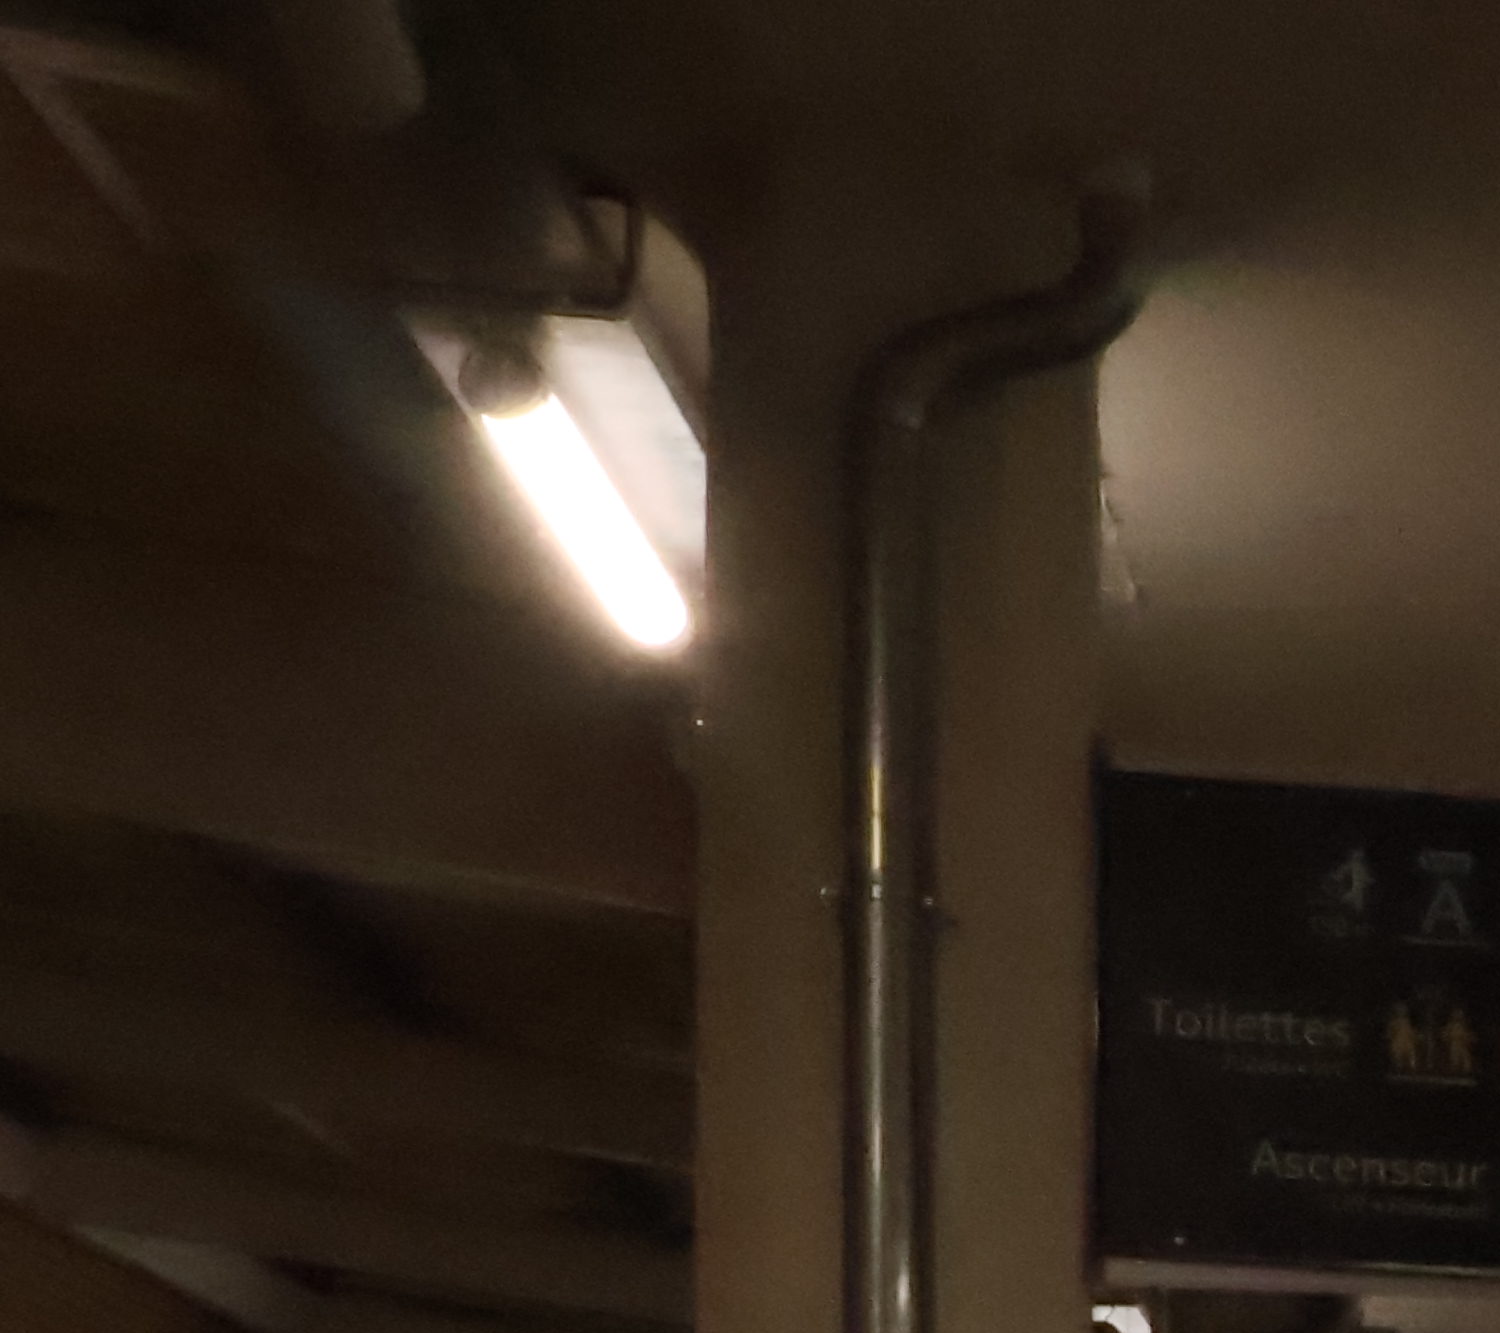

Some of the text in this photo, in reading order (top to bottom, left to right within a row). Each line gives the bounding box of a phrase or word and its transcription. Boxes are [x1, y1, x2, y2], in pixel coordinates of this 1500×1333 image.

[1422, 879, 1473, 936] A
[1146, 995, 1352, 1048] Toilettes
[1251, 1139, 1487, 1190] Ascenseur
